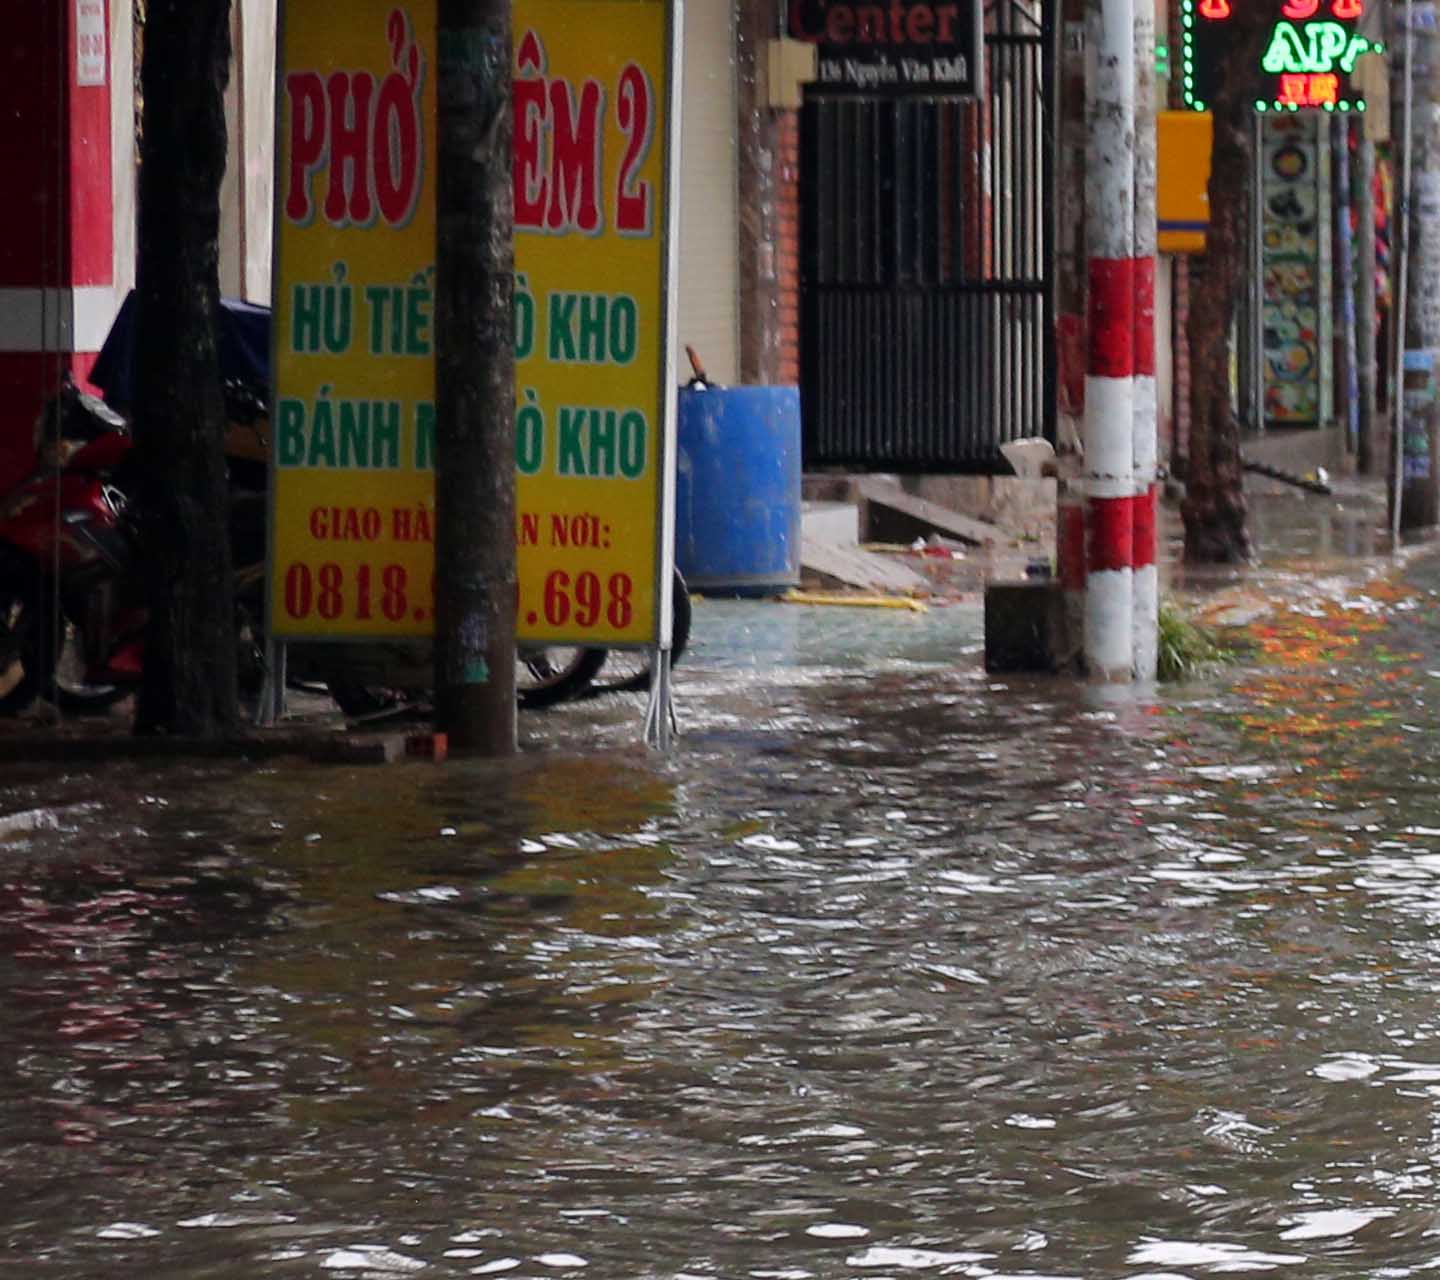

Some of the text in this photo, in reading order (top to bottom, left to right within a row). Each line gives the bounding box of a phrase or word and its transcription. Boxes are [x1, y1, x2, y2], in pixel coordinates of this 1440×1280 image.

[845, 48, 898, 89] Nguyễn
[285, 7, 654, 234] PHỞ ÊM 2
[290, 261, 352, 355] HỦ
[365, 263, 438, 358] TIẾ
[548, 290, 640, 365] KHO
[275, 384, 402, 470] BÁNH
[557, 406, 649, 480] KHO
[308, 505, 382, 543] GIAO
[550, 510, 612, 551] NƠI:
